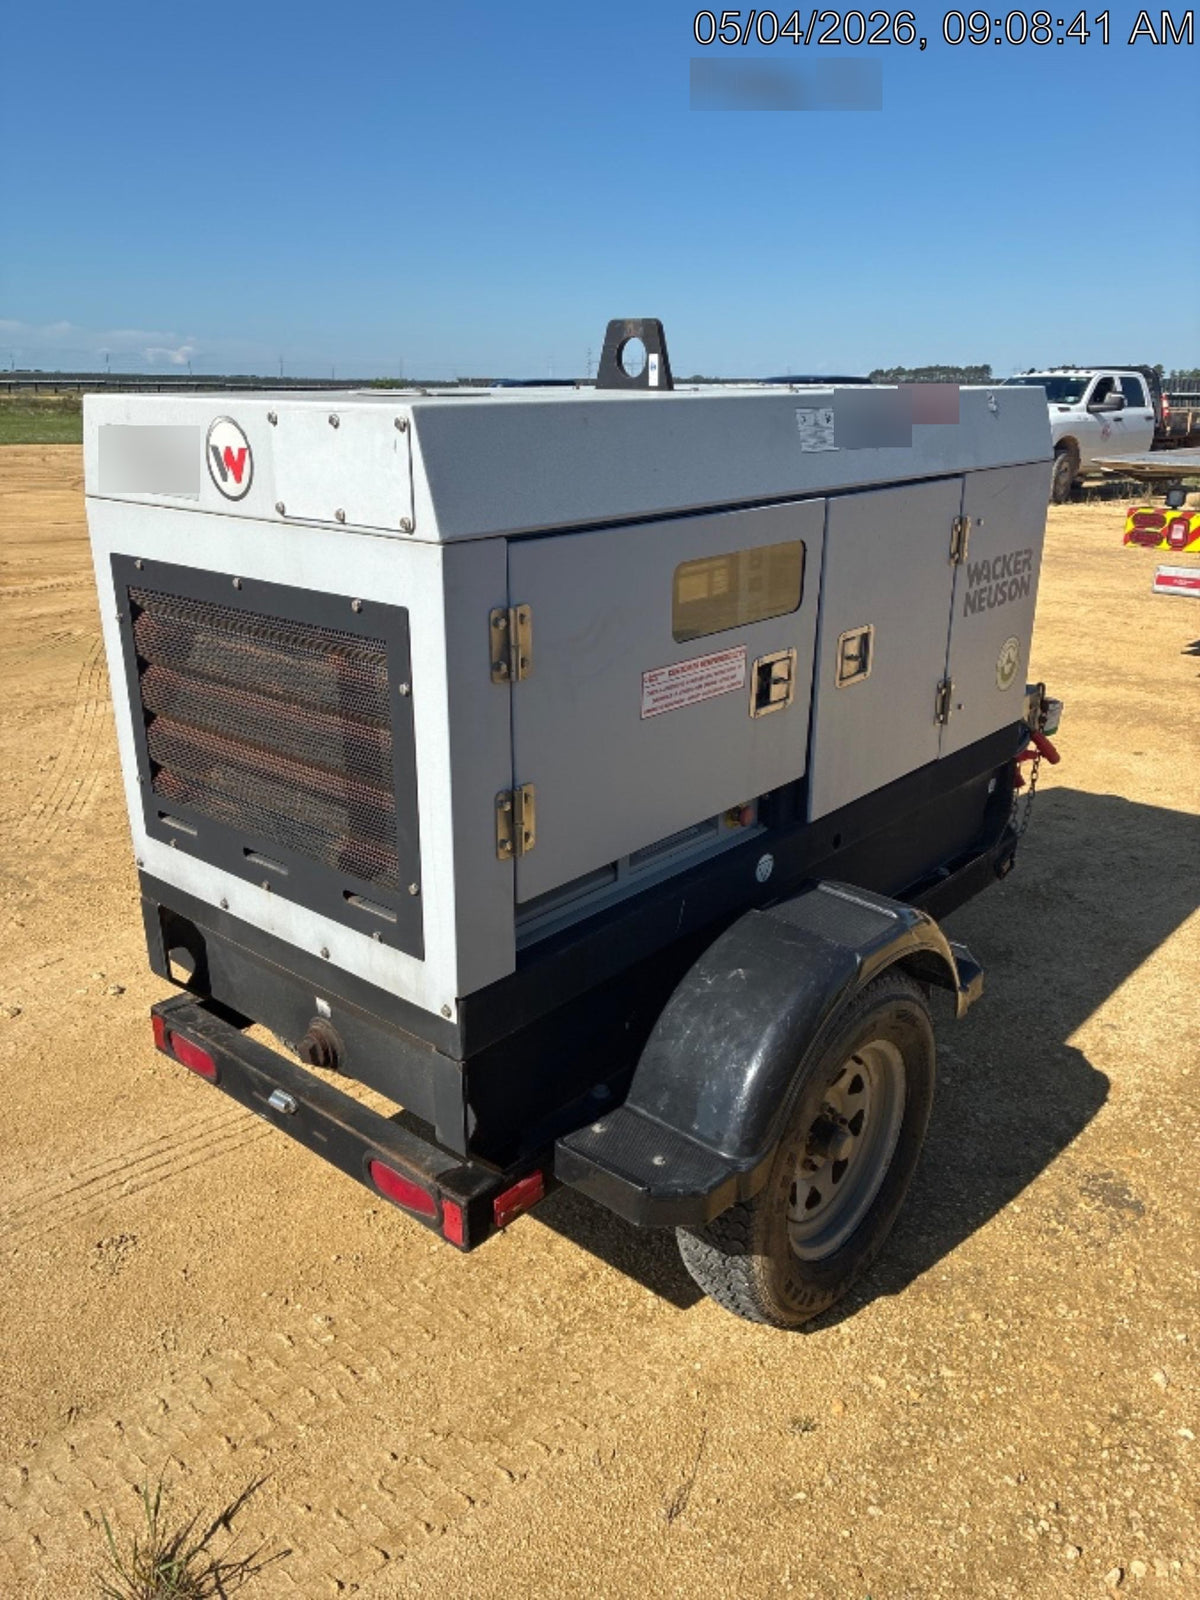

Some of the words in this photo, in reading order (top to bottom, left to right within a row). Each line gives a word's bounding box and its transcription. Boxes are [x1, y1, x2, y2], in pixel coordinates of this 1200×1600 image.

[210, 445, 249, 484] W
[966, 548, 1033, 588] WACKER
[963, 575, 1031, 617] NEUSON
